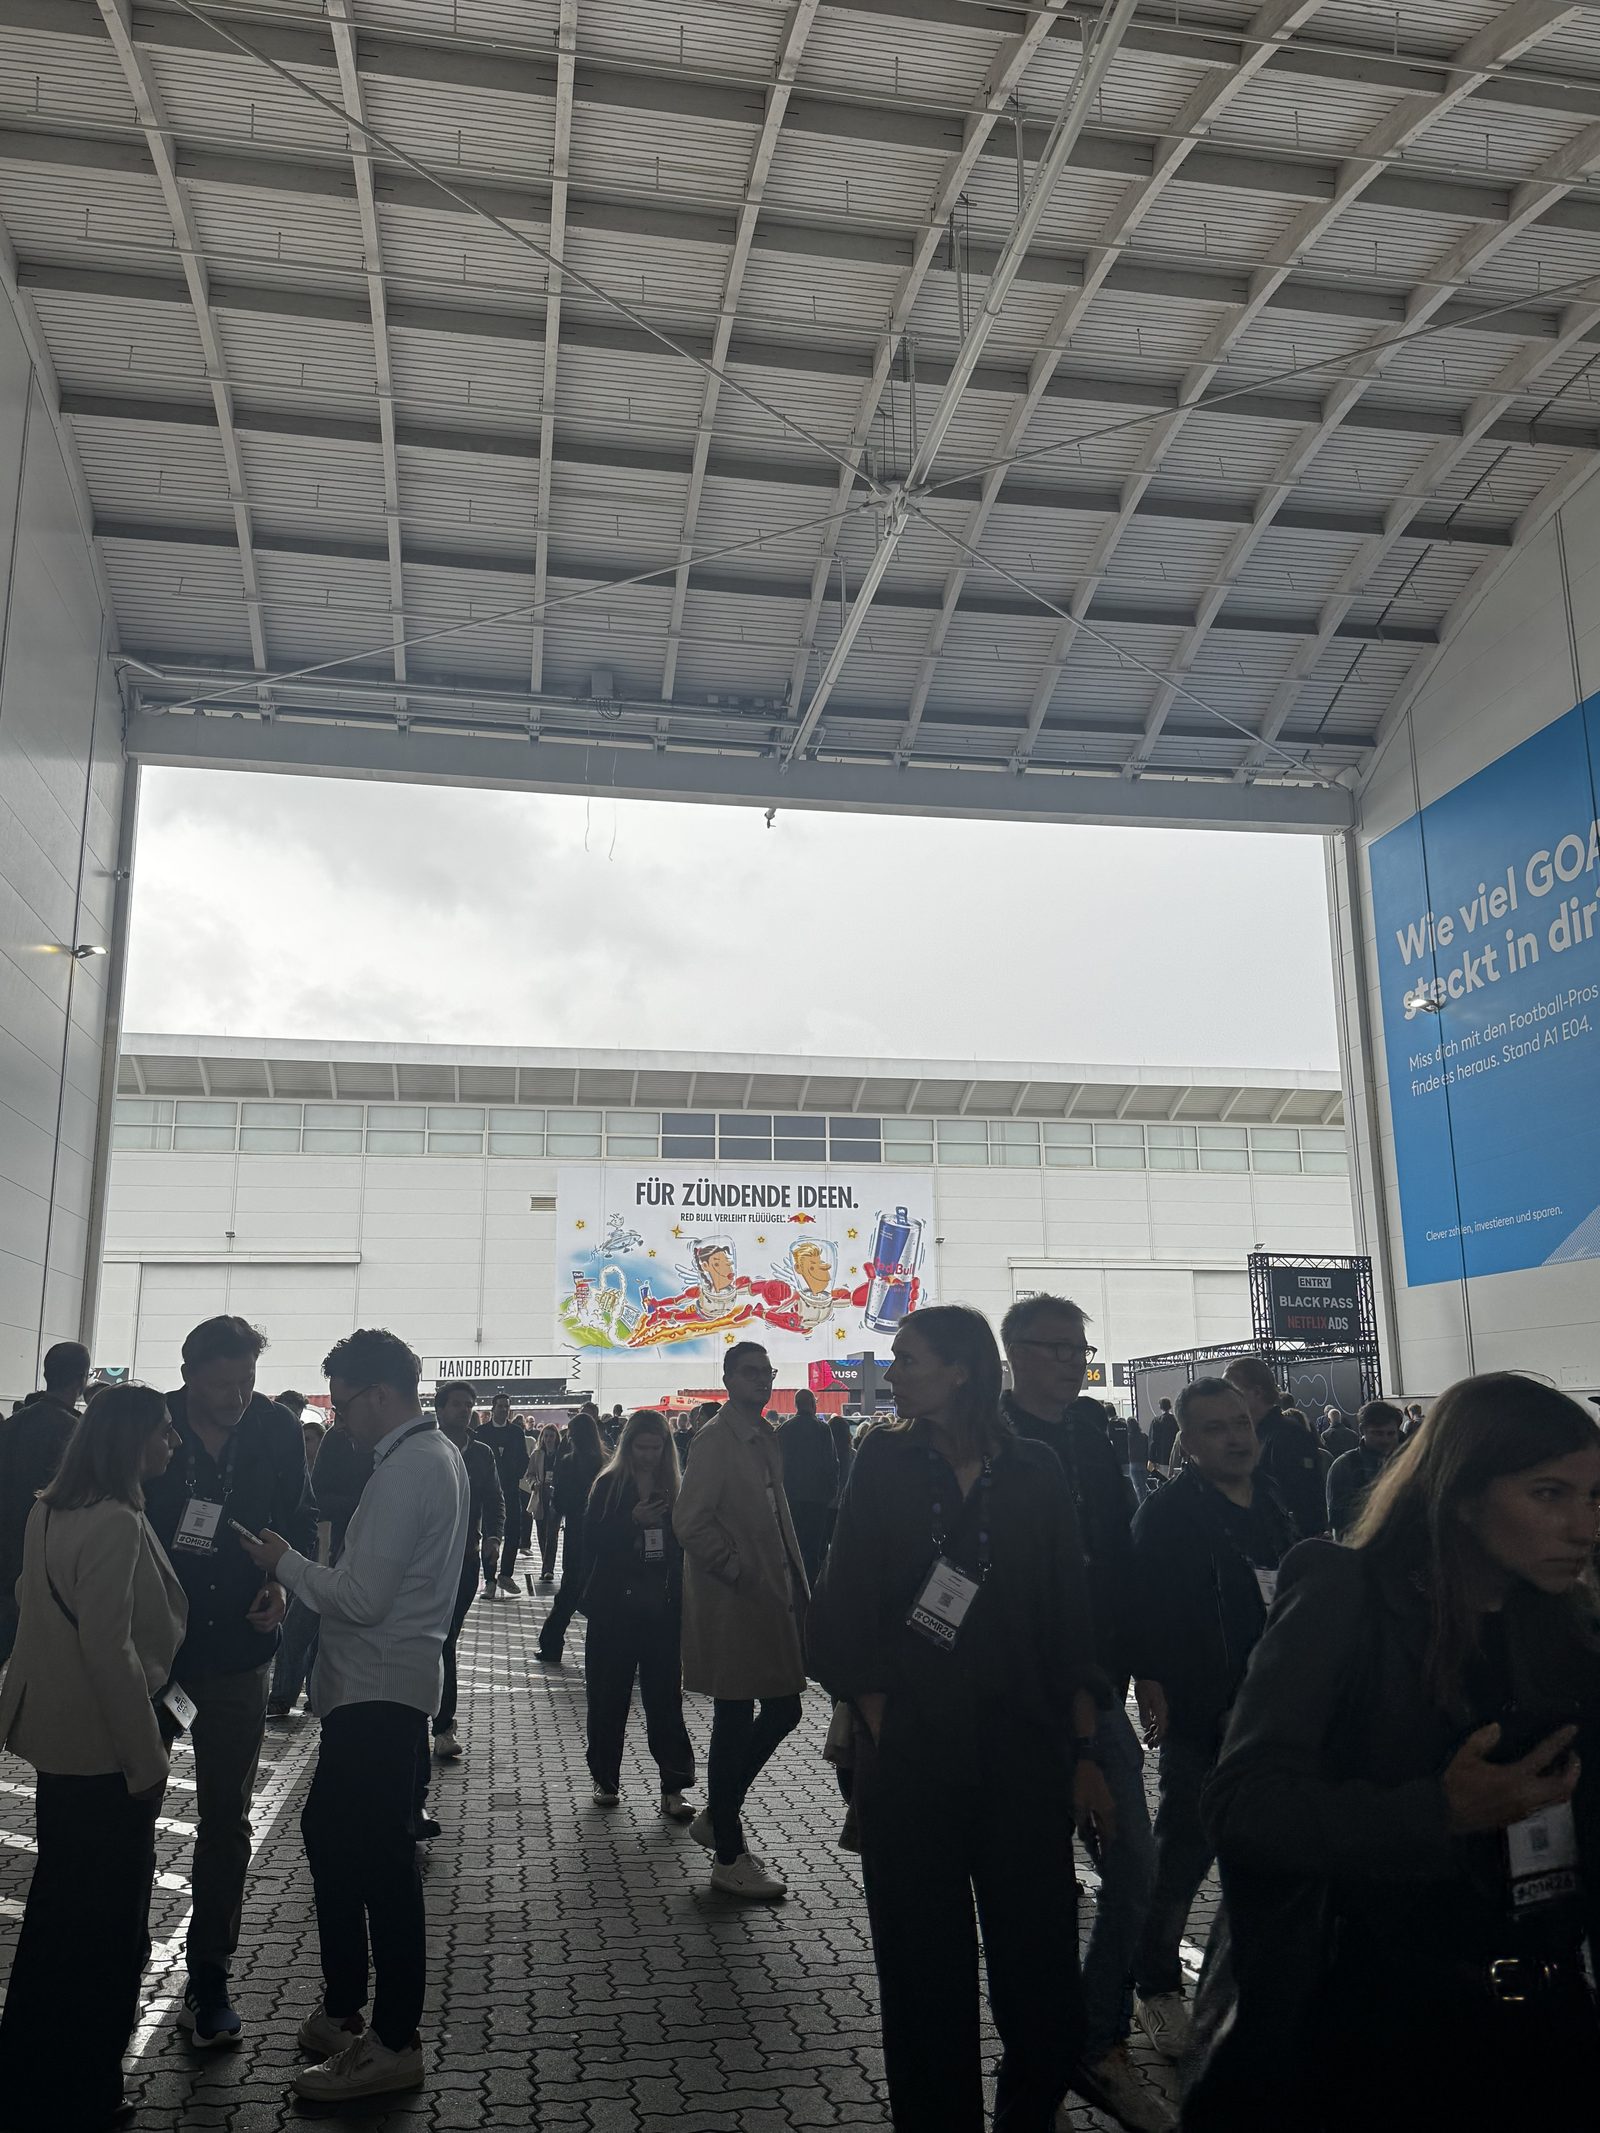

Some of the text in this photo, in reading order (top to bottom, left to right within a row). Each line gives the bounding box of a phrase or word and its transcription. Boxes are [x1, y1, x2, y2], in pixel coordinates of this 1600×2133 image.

[1396, 911, 1454, 966] Wie
[1459, 865, 1518, 933] viel
[1403, 888, 1600, 1020] steckt in dir
[1409, 1052, 1433, 1072] Miss
[1461, 1030, 1481, 1051] mit
[1483, 1023, 1507, 1042] den
[1509, 984, 1599, 1032] Football-Pros
[1411, 1014, 1593, 1097] finde es heraus. Stand A1 E04.
[636, 1176, 859, 1209] FÜR ZÜNDENDE IDEEN.
[680, 1212, 695, 1222] RED
[696, 1213, 713, 1222] BULL
[714, 1213, 747, 1223] VERLEIHT
[1426, 1229, 1448, 1242] Clever
[1474, 1216, 1515, 1232] investieren
[1515, 1209, 1531, 1224] und
[1532, 1206, 1563, 1222] sparen.
[1300, 1277, 1330, 1288] ENTRY
[1279, 1295, 1353, 1309] BLACK PASS
[1287, 1315, 1349, 1331] NETFLIX ADS
[439, 1359, 533, 1378] HANDBROTZEIT
[179, 1536, 210, 1548] #OMR26
[914, 1611, 955, 1639] #OMR26
